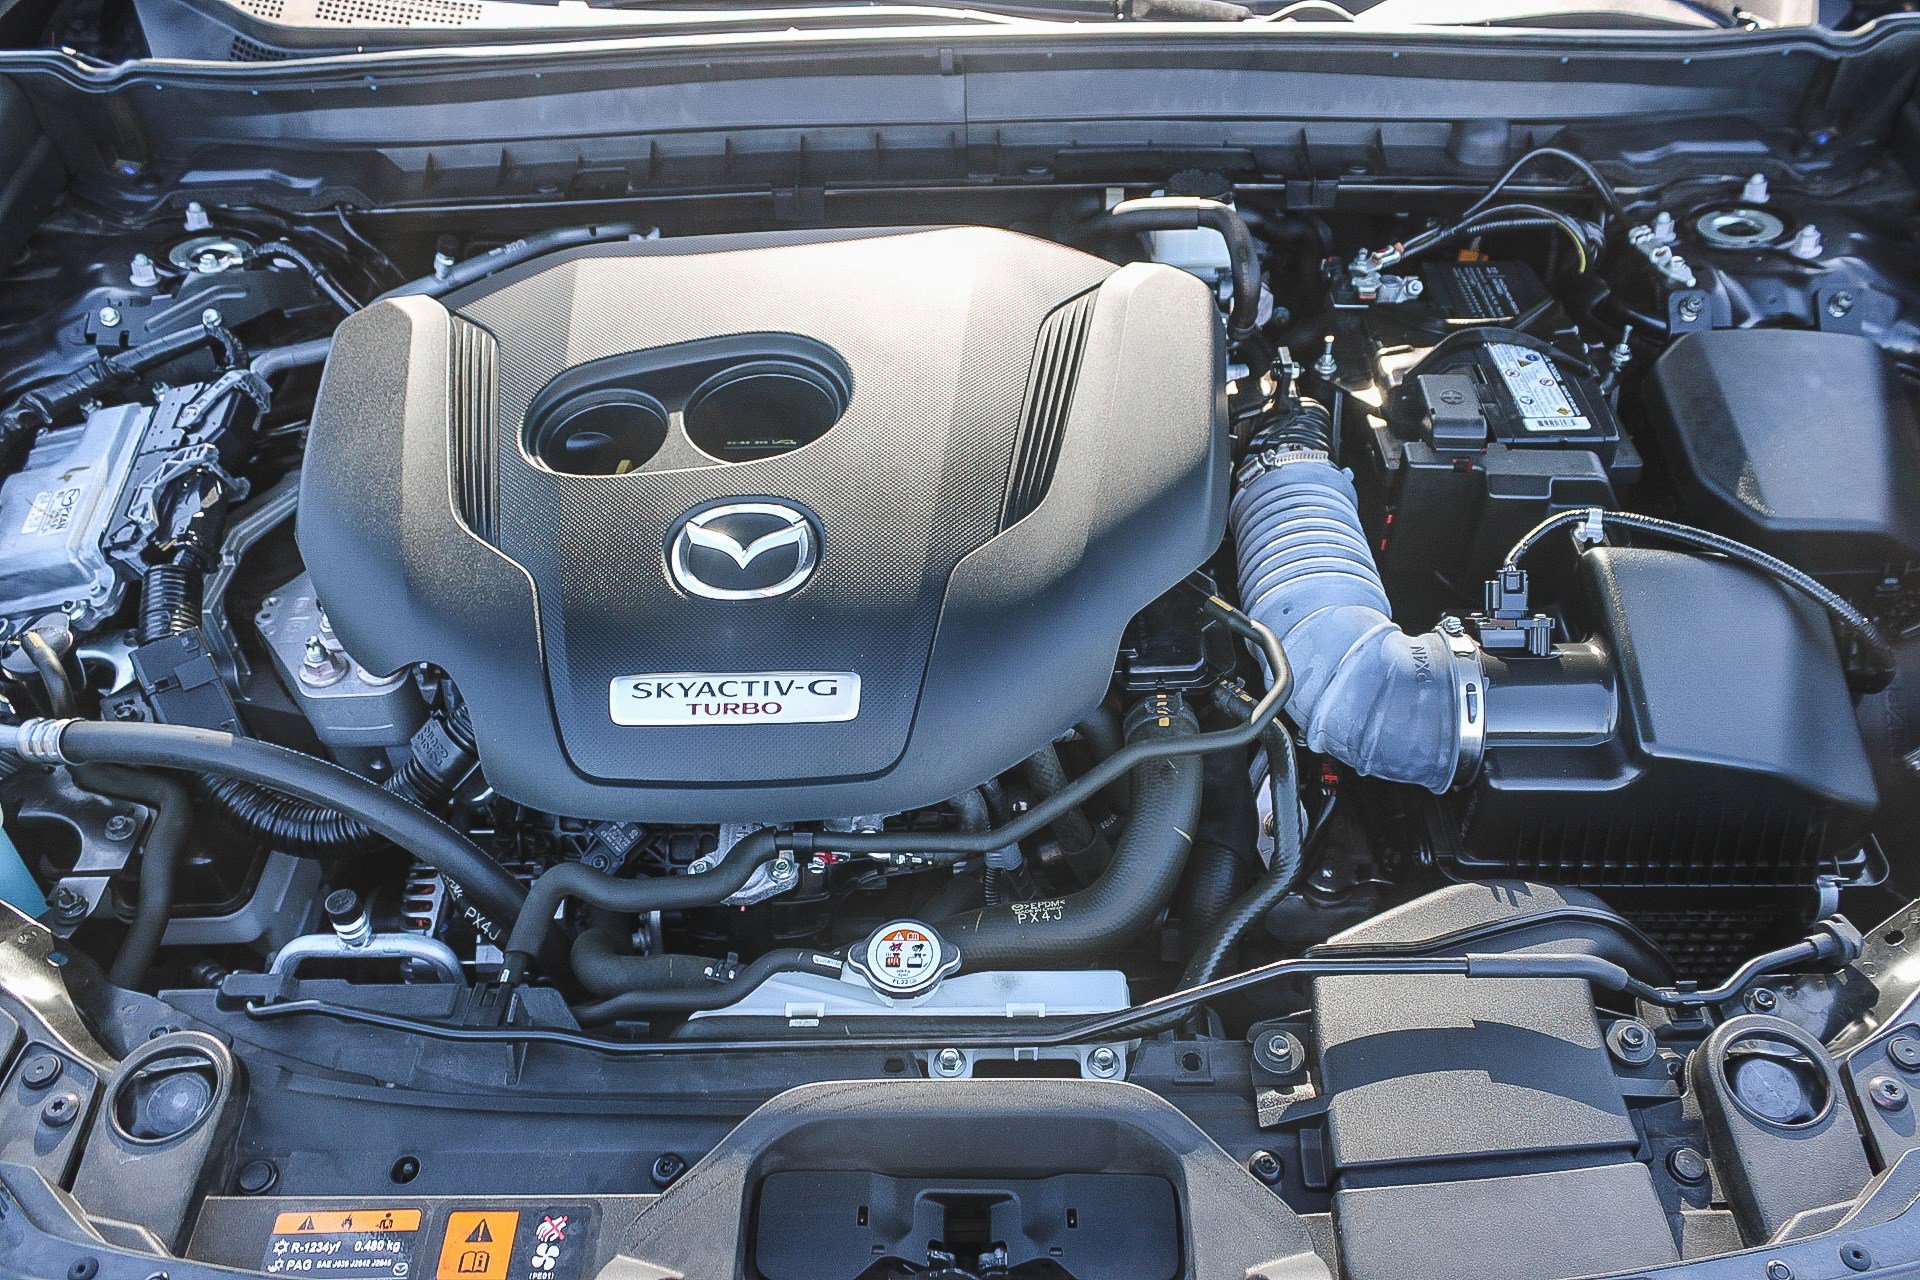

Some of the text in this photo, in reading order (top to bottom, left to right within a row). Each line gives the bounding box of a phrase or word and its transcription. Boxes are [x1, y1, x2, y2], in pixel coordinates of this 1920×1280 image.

[631, 679, 838, 699] SKYACTIV-G
[686, 701, 783, 716] TURBO
[463, 906, 501, 941] PX4J
[290, 1240, 342, 1256] R-1234yf
[386, 1240, 401, 1253] kg
[285, 1259, 313, 1271] PAG
